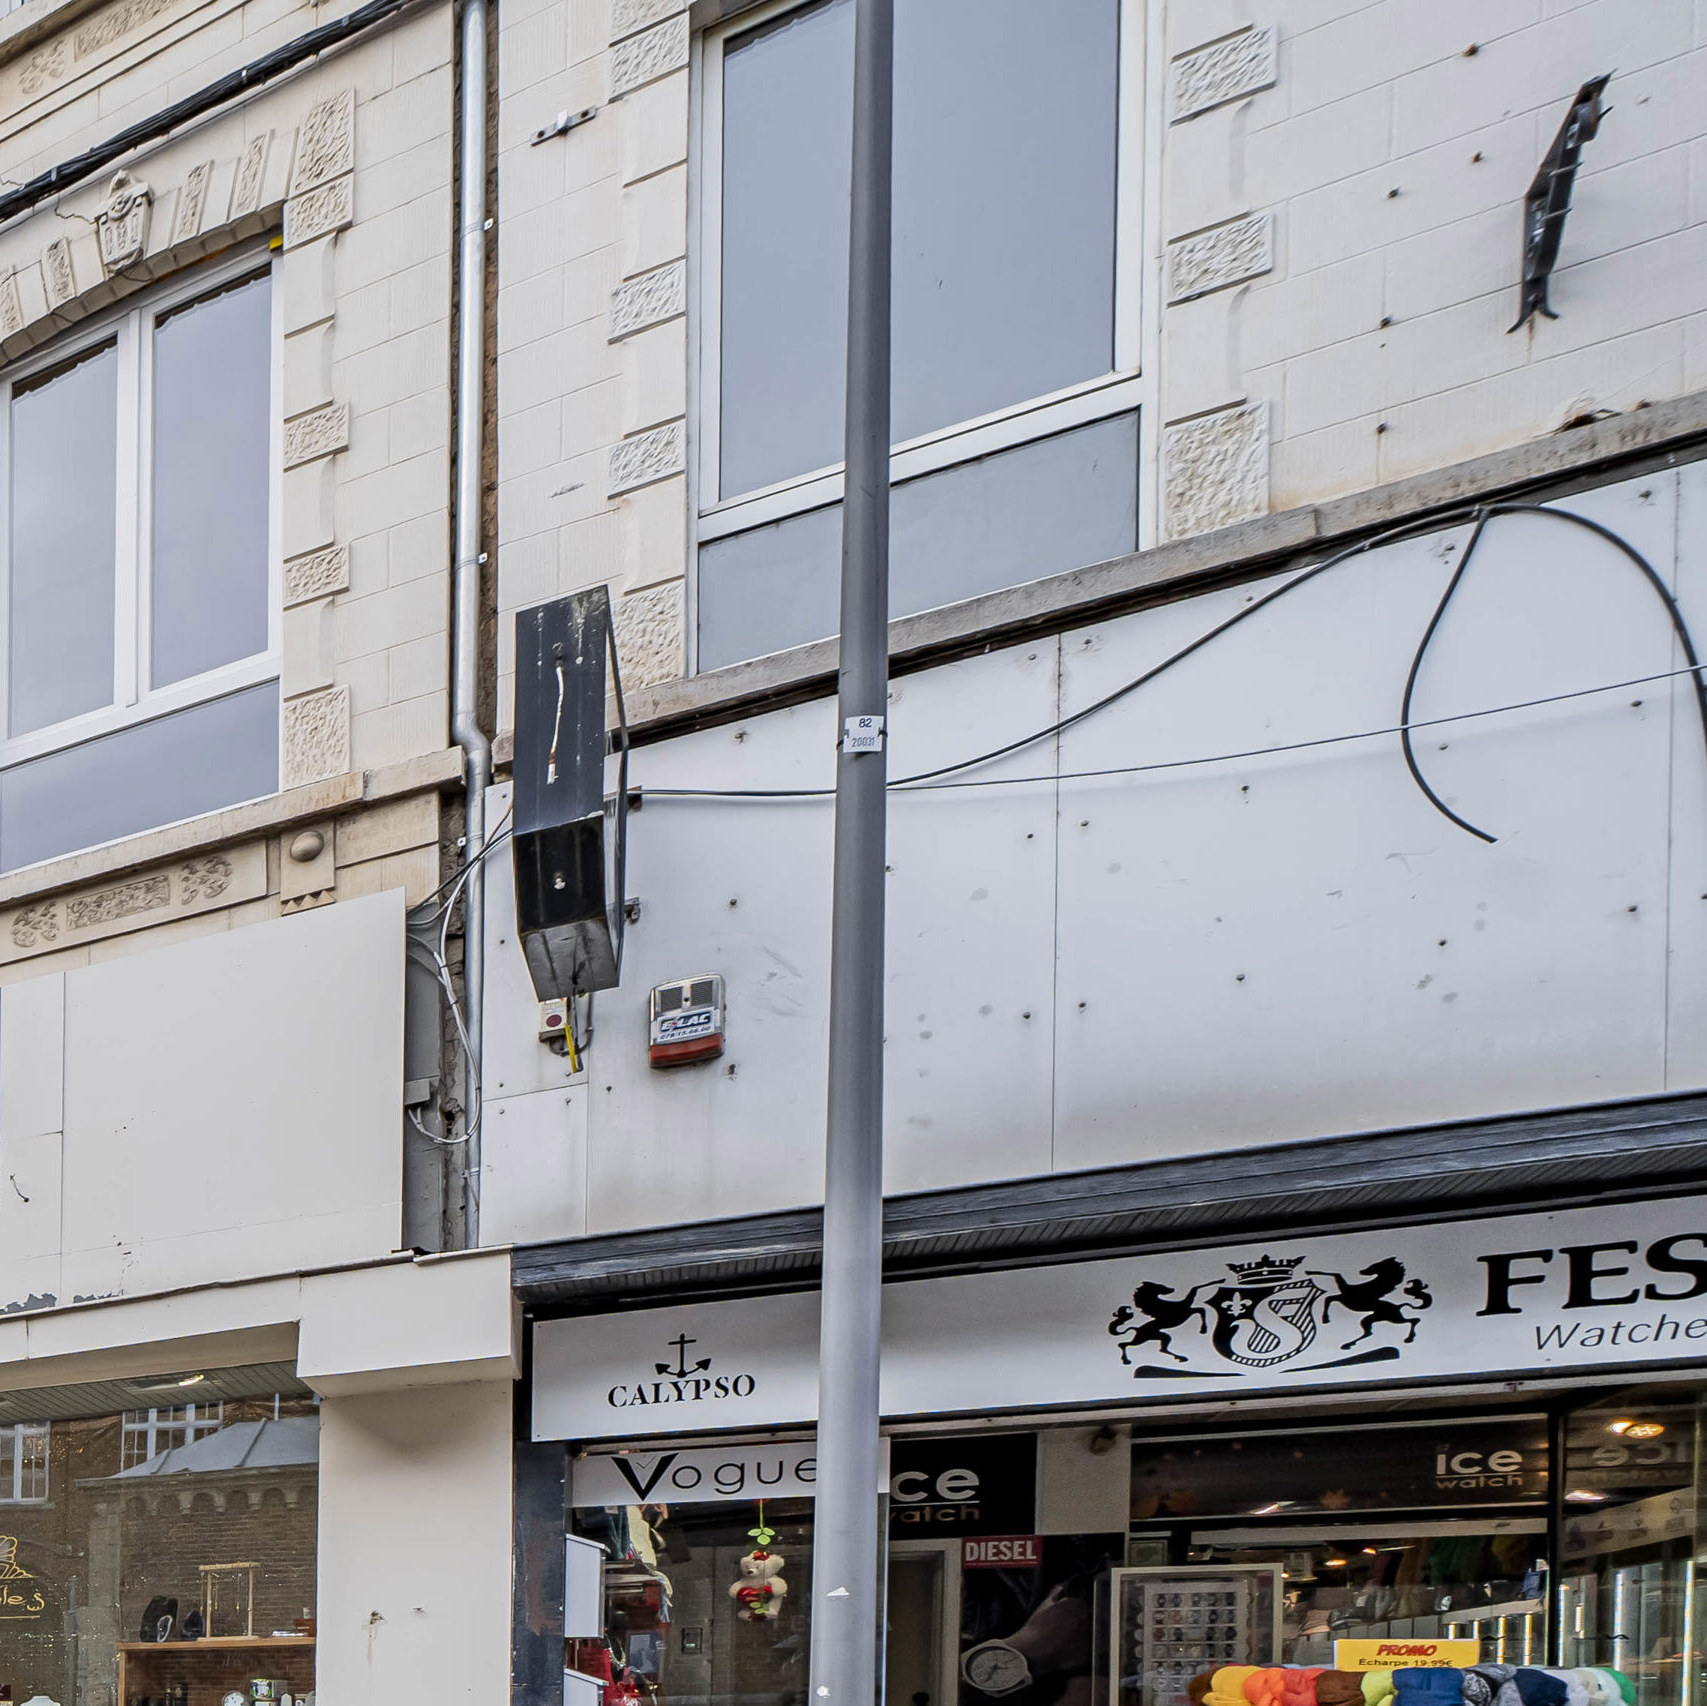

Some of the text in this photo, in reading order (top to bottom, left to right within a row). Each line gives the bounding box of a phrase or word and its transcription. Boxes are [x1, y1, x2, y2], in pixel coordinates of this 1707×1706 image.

[1475, 1232, 1707, 1317] FES
[1535, 1314, 1707, 1352] Watche
[607, 1374, 756, 1408] CALYPSO
[1436, 1444, 1523, 1474] ice
[611, 1453, 817, 1502] Vogue
[889, 1468, 980, 1502] ce
[1436, 1475, 1523, 1489] watch
[965, 1540, 1037, 1562] DIESEL
[1377, 1644, 1438, 1657] PROMO
